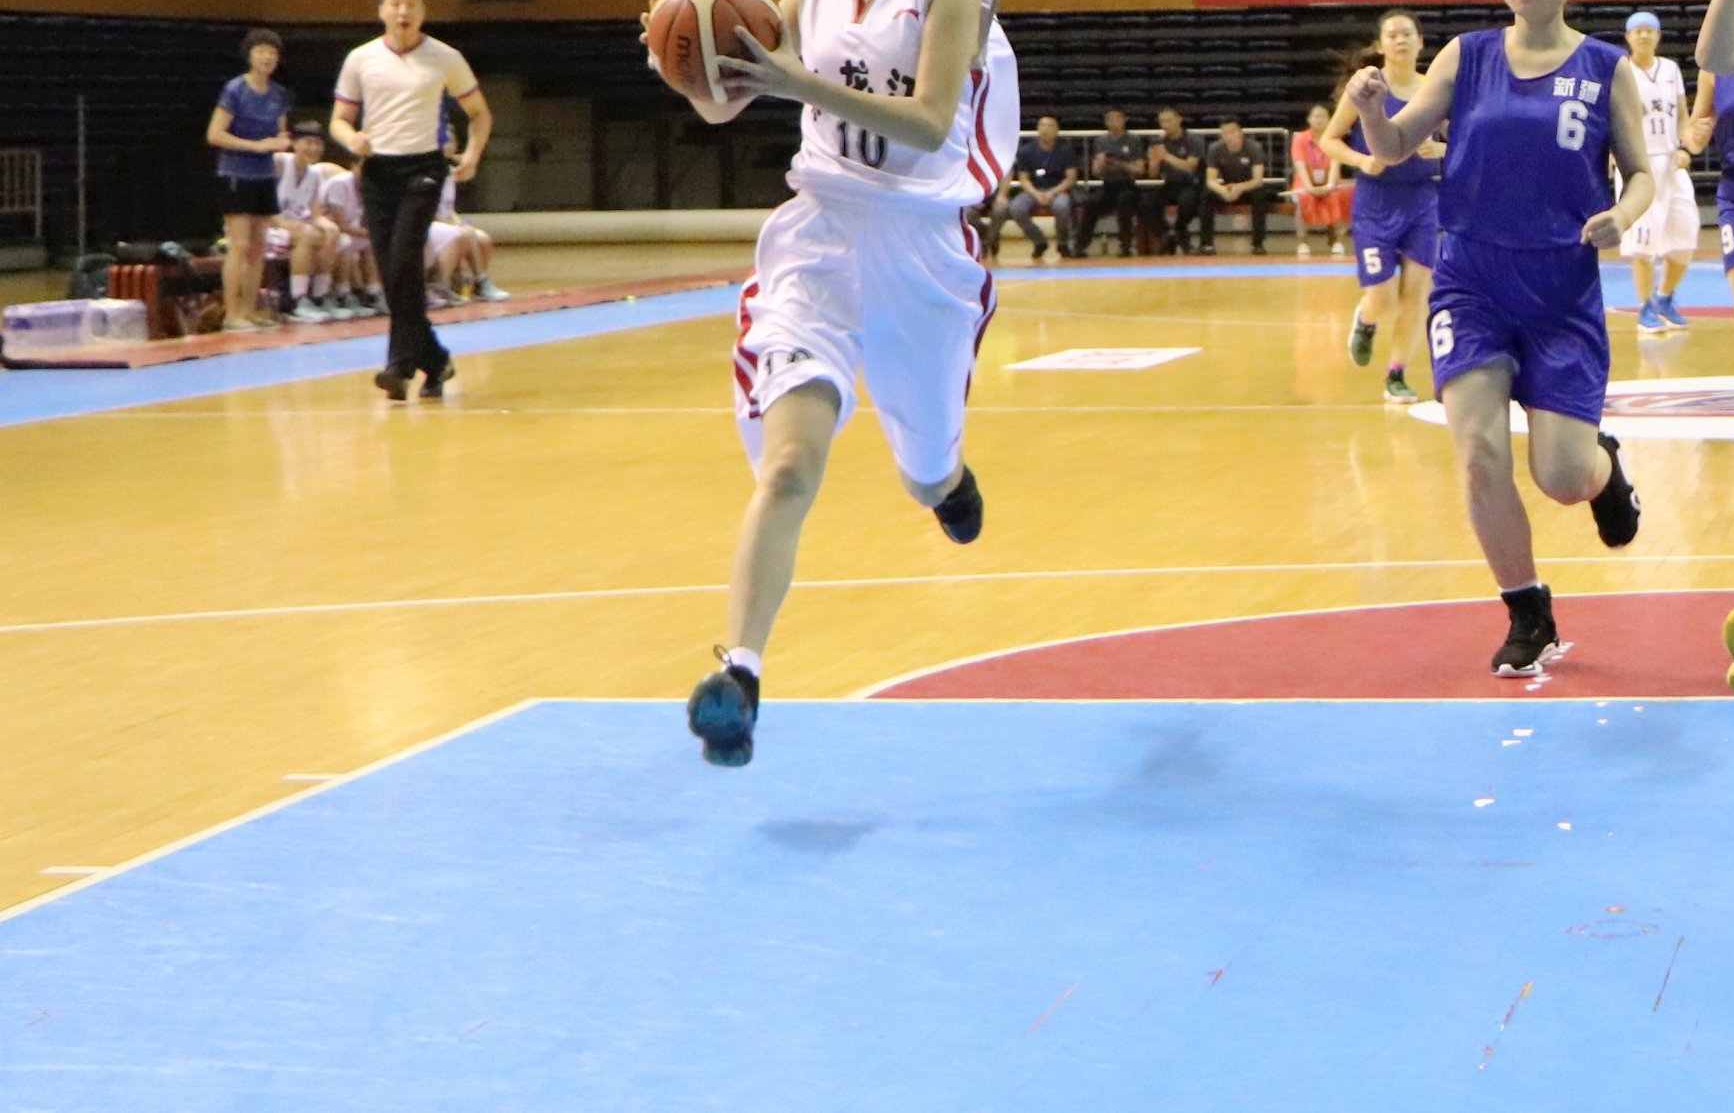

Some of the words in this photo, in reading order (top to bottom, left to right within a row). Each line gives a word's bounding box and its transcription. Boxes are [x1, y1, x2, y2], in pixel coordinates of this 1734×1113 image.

[838, 121, 889, 169] 10
[1556, 100, 1589, 151] 6
[1649, 117, 1666, 135] 11
[1720, 223, 1734, 254] 9
[1363, 247, 1381, 274] 5
[1431, 308, 1454, 360] 6
